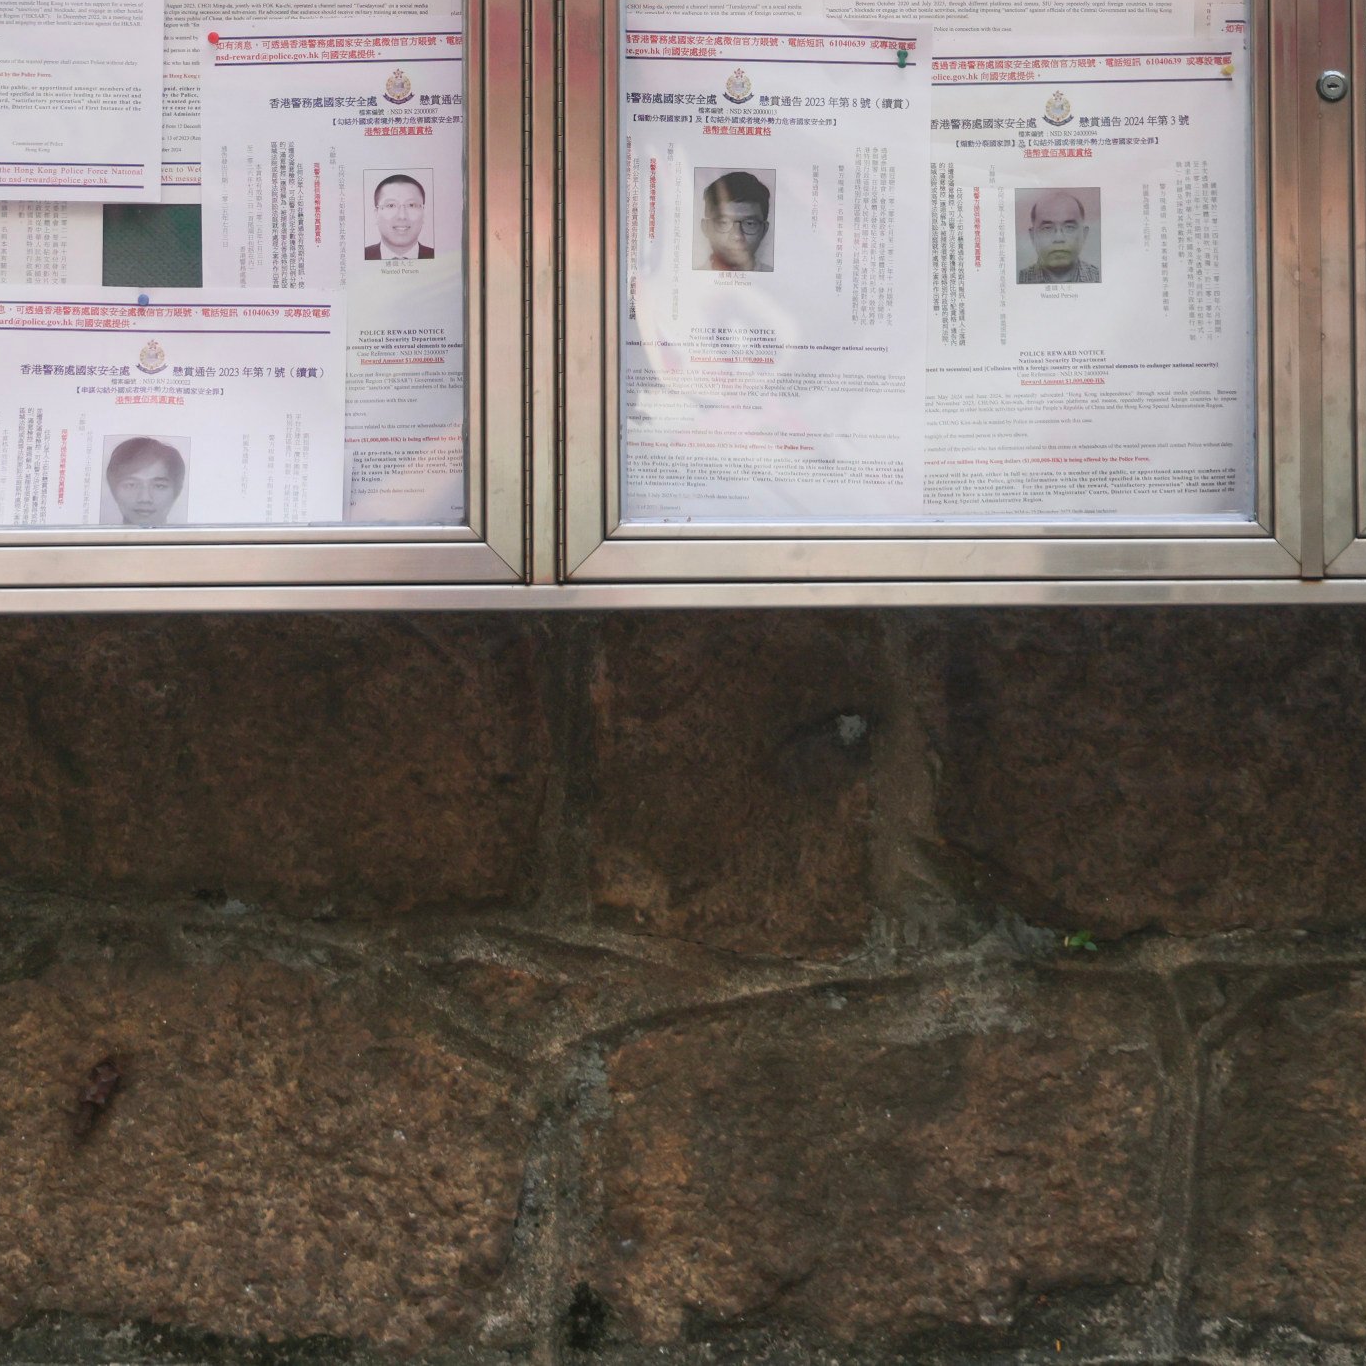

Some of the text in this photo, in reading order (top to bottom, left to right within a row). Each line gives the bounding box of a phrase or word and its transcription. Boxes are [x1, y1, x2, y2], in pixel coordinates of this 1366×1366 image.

[216, 52, 319, 61] nsd-reward@police.gov.hk
[270, 97, 377, 108] 香港警務處國家安全處
[760, 96, 849, 108] 懸賞通告 2023 年第
[1079, 116, 1121, 127] 懸賞通告
[1125, 117, 1144, 125] 2024
[1147, 115, 1168, 126] 年第
[1179, 115, 1189, 125] 號
[14, 167, 33, 175] Hong
[38, 168, 57, 176] Kong
[21, 365, 263, 377] 香港警務處國家安全處 懸賞通告 2023 年第
